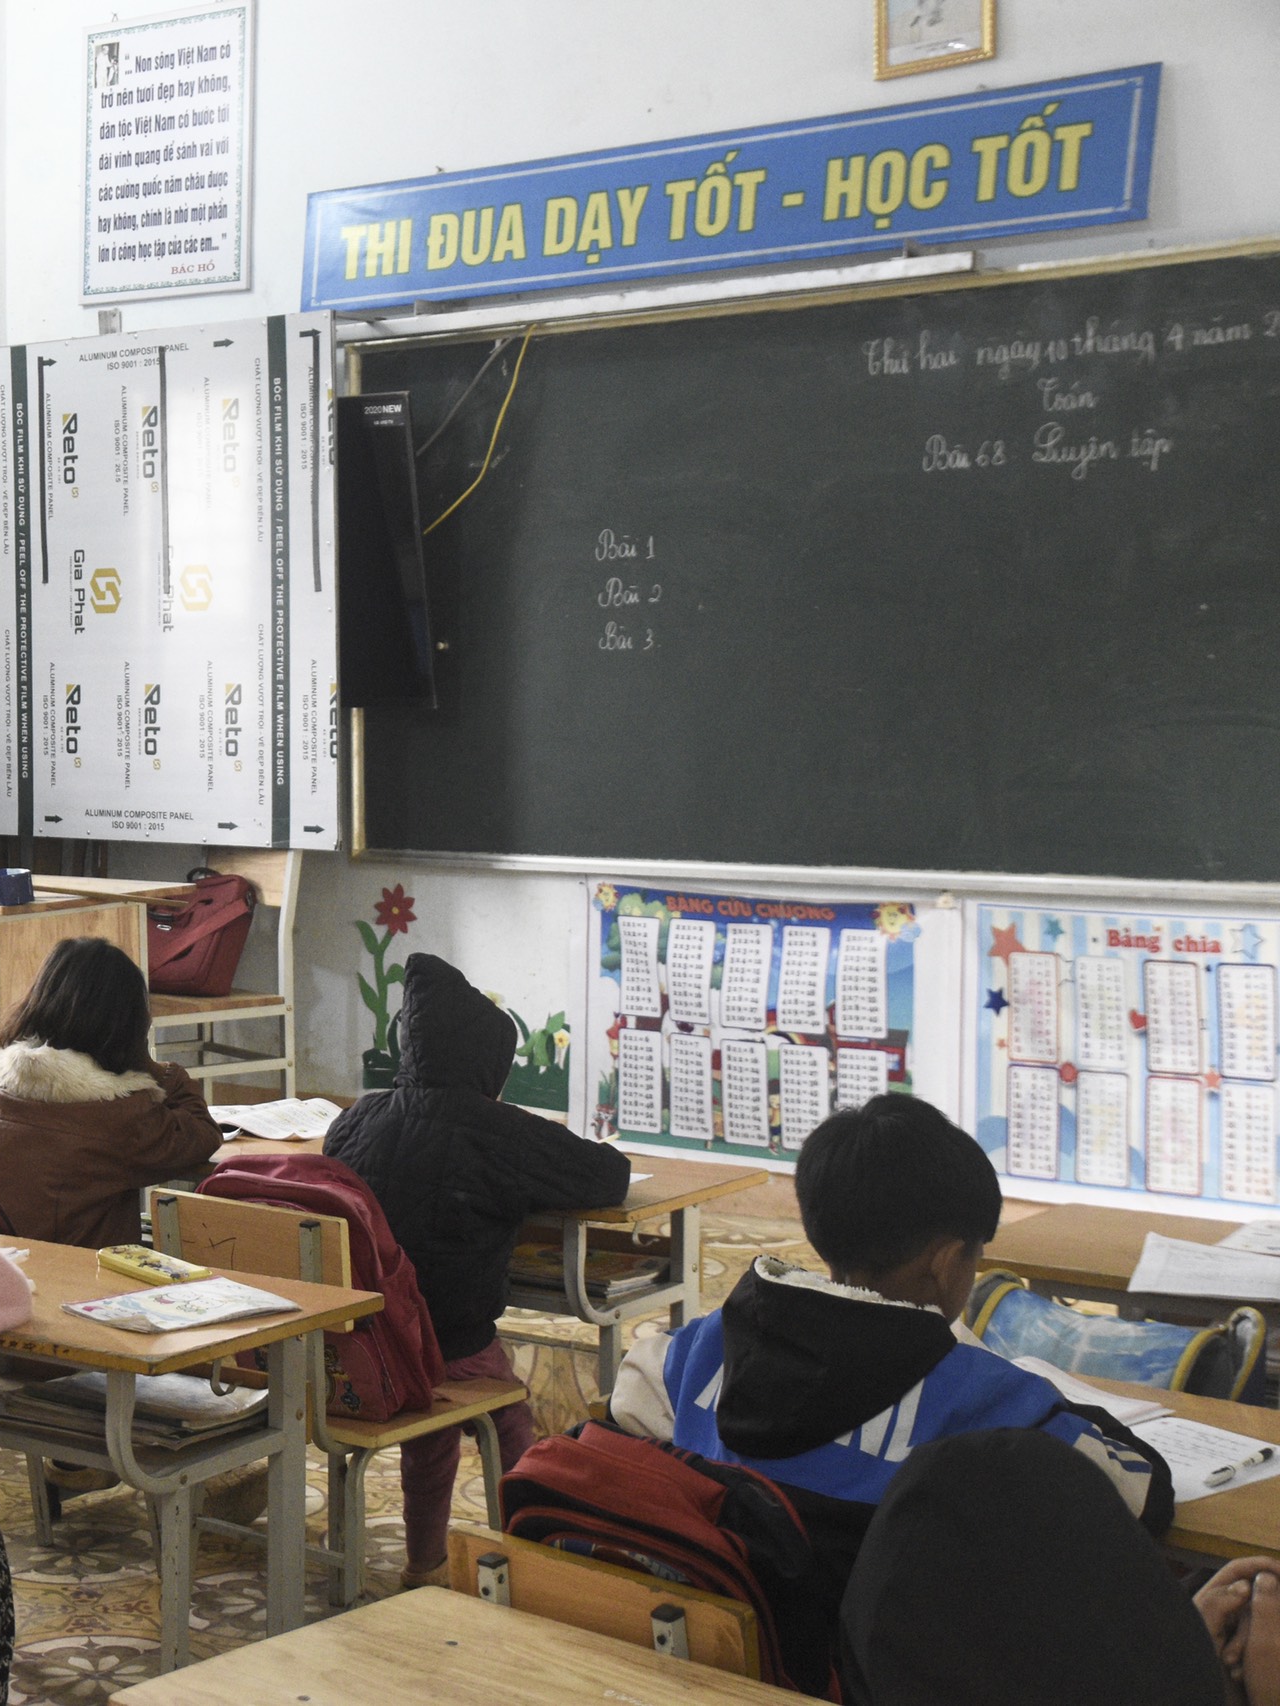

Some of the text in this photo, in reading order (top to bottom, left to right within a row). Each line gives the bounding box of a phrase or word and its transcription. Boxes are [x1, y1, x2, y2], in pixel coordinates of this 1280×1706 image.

[135, 55, 151, 73] Non
[155, 51, 175, 70] sông
[177, 47, 194, 69] Việt
[197, 45, 217, 63] Nam
[220, 40, 231, 59] có
[101, 74, 231, 109] trở nên tươi đẹp hay không,
[100, 103, 230, 140] dân tộc Việt Nam có bước tới
[340, 100, 1095, 281] THI ĐUA DẠY TỐT - HỌC TỐT
[171, 258, 216, 275] BÁC HỒ
[79, 342, 189, 362] ALUMINUM COMPOSIT PANEL
[107, 357, 161, 371] ISO 9001 2015
[274, 377, 284, 401] BÓC
[1036, 376, 1100, 411] Toán
[16, 402, 26, 425] BÓC
[63, 412, 79, 485] Reto
[142, 405, 159, 479] Reto
[222, 398, 241, 473] Reto
[275, 435, 283, 455] KHI
[275, 458, 285, 476] SỬ
[18, 478, 27, 494] SỬ
[273, 479, 283, 512] DỤNG
[16, 498, 26, 526] DỤNG
[19, 539, 27, 566] PEEL
[276, 525, 284, 555] PEEL
[595, 528, 655, 561] Bài 1
[276, 558, 284, 580] OFF
[20, 593, 28, 614] THE
[74, 549, 86, 635] Gia Phat
[276, 583, 284, 606] THE
[598, 577, 662, 606] Bài 2
[20, 616, 28, 682] PROTECTIVE
[276, 609, 284, 681] PROTECTIVE
[276, 684, 284, 710] FILM
[65, 683, 81, 754] Reto
[144, 683, 161, 755] Reto
[225, 682, 242, 757] Reto
[276, 713, 284, 749] WHEN
[276, 750, 284, 786] USING
[84, 808, 195, 821] ALUMINUM COMPOSITE PANEL
[111, 820, 165, 831] ISO 9001 2015
[666, 893, 835, 921] BẢNG CỬU CHƯƠNG
[1107, 926, 1223, 953] Bảng chia
